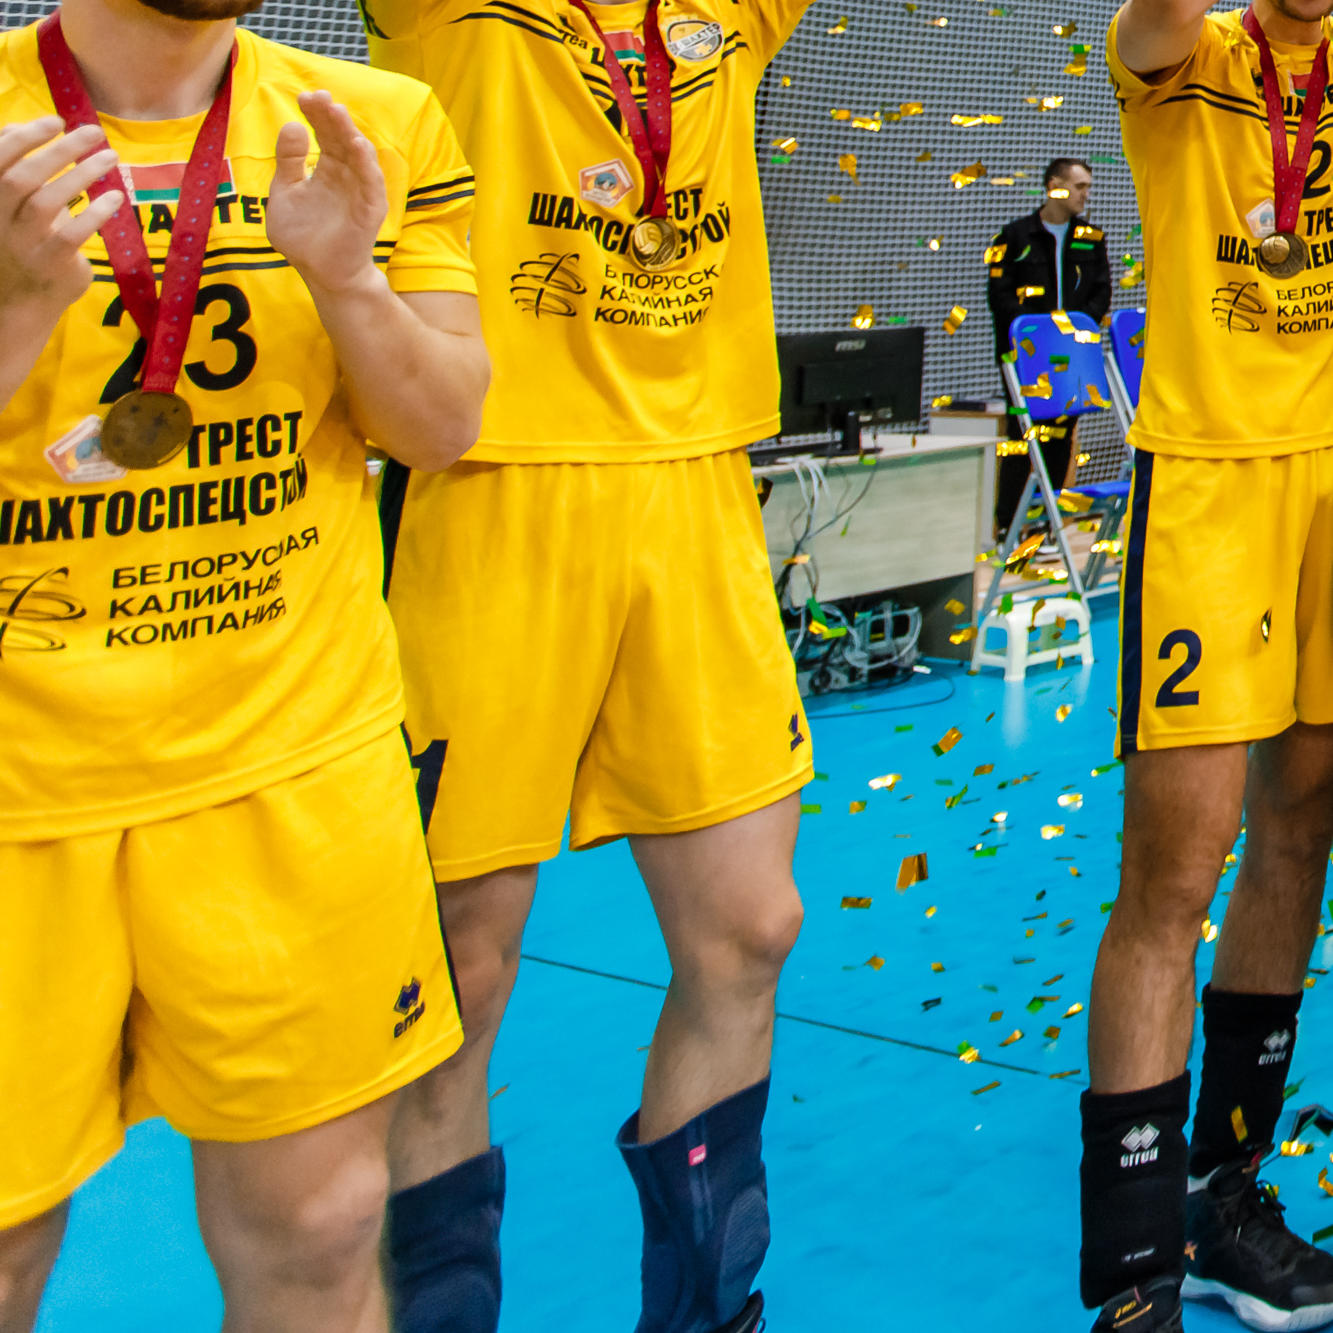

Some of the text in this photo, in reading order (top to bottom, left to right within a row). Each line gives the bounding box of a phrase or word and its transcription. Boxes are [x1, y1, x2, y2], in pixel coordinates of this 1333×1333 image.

[594, 306, 709, 327] КОМПАНИ
[186, 410, 303, 469] ТРЕСТ
[105, 597, 287, 649] КОМПАНИЯ
[1155, 629, 1202, 708] 2
